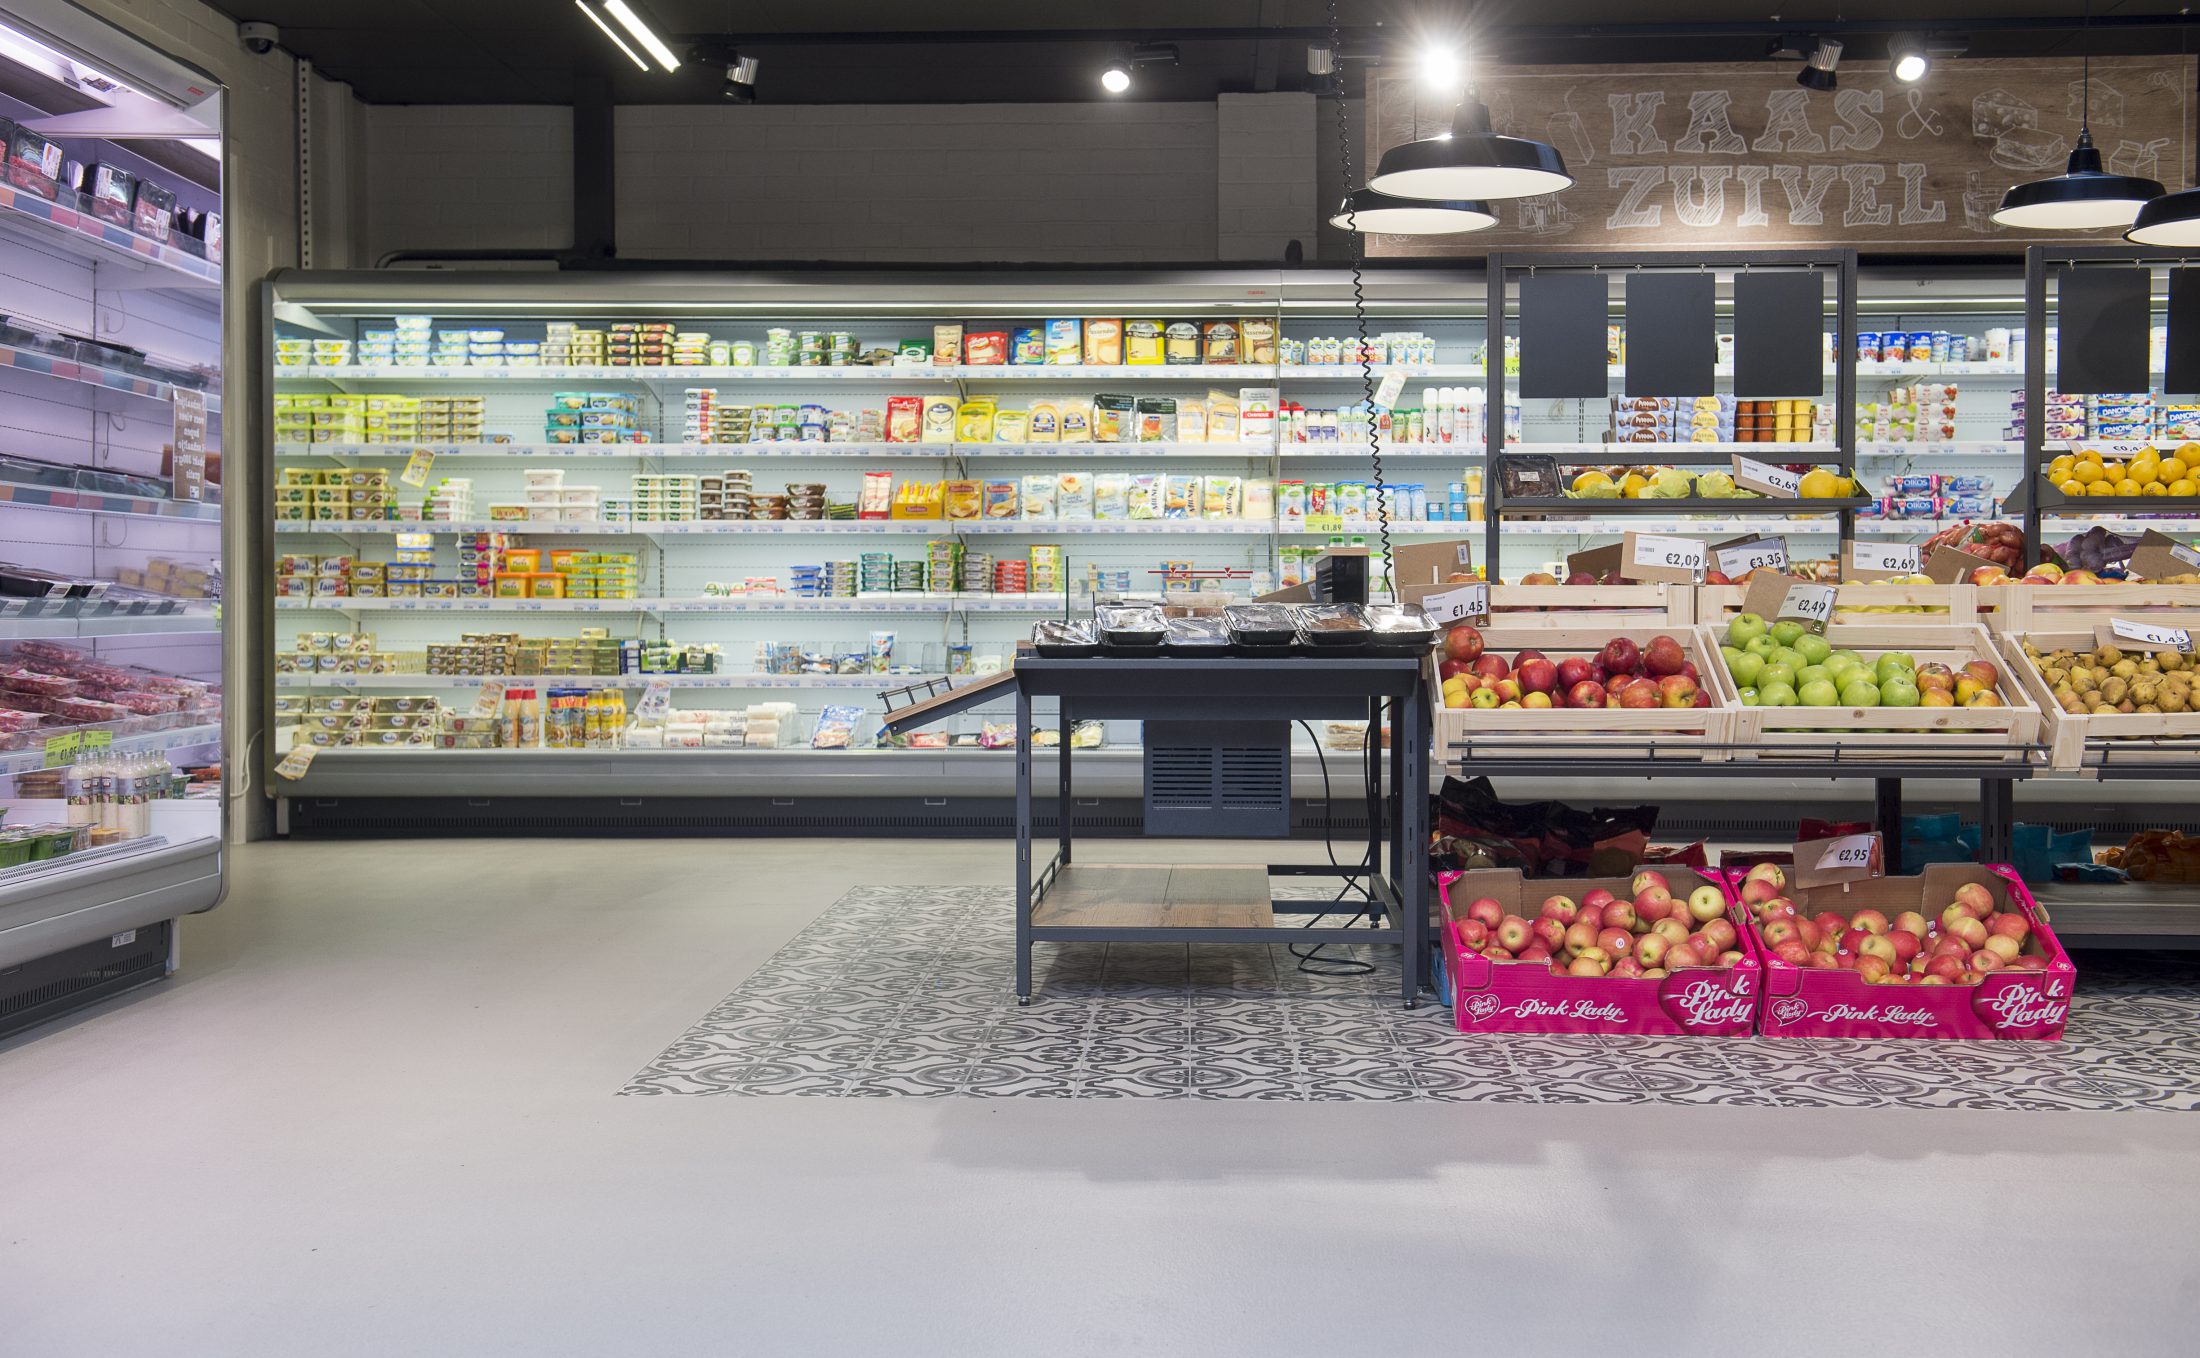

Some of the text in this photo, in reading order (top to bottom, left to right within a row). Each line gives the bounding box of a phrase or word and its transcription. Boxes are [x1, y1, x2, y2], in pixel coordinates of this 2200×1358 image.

[1607, 88, 1943, 155] KAAS &
[1605, 163, 1947, 229] ZUIVEL
[1768, 474, 1798, 492] €2,69
[1904, 478, 1928, 487] OIKOS
[1906, 501, 1931, 510] OIKOS
[1321, 523, 1342, 533] €1,89
[1883, 557, 1916, 570] €2,69
[1452, 600, 1483, 617] €1,45
[1797, 598, 1827, 615] €2,49
[1838, 848, 1869, 863] €2,95
[1470, 1000, 1492, 1010] Pink
[1500, 999, 1570, 1018] Pink
[1688, 997, 1753, 1026] Lady
[1777, 1005, 1800, 1014] Pink
[1807, 1004, 1880, 1022] Pink
[1996, 1000, 2067, 1029] Lady
